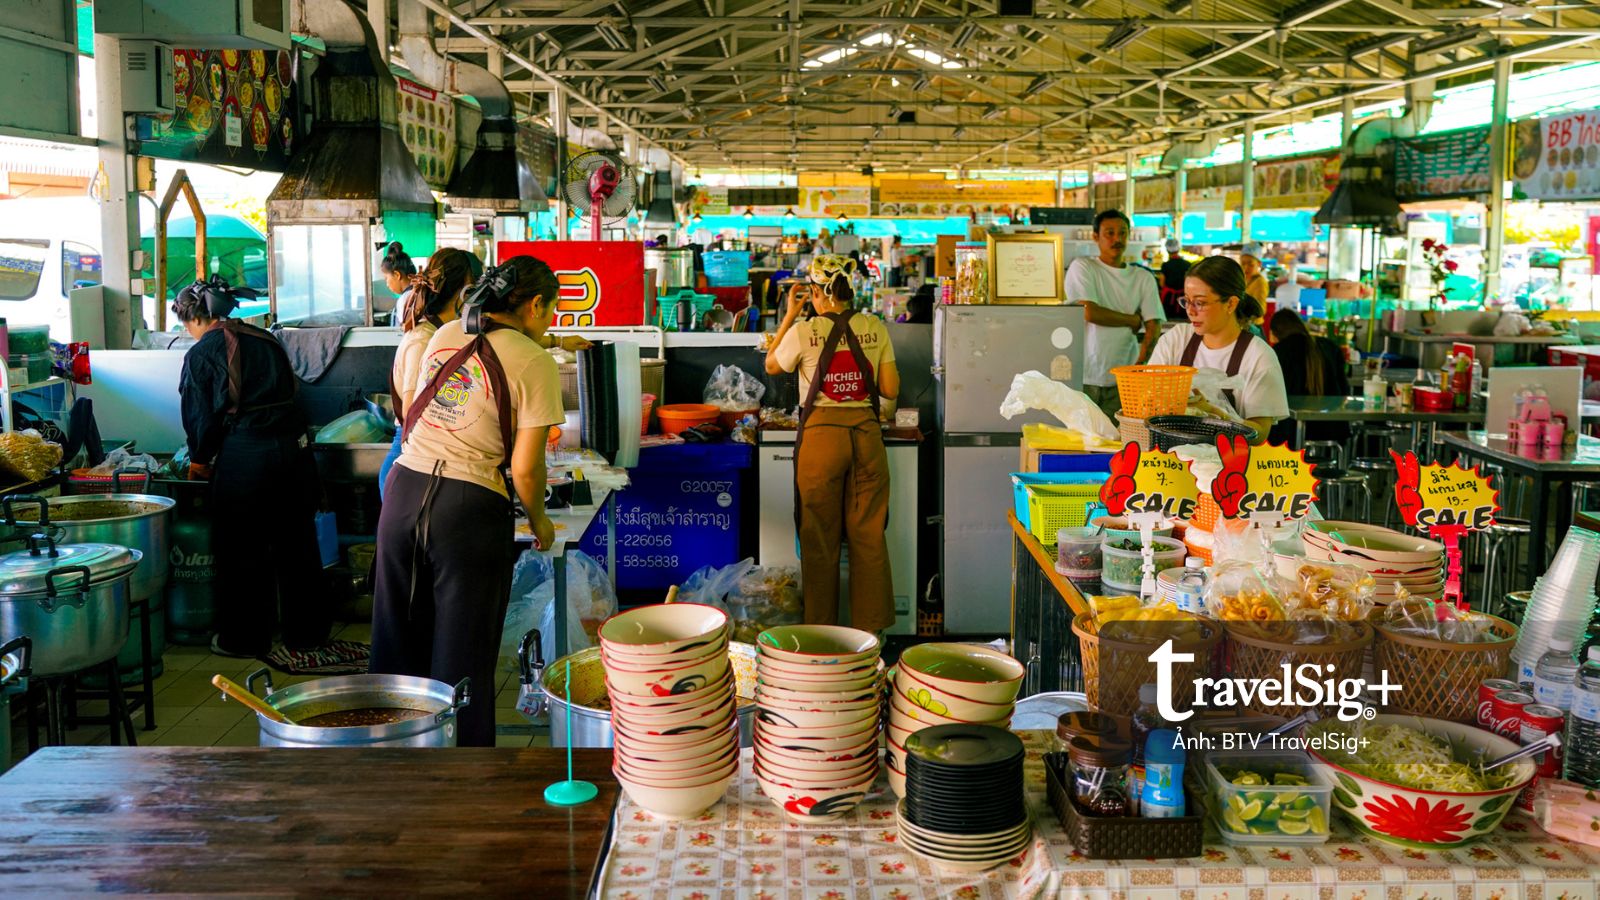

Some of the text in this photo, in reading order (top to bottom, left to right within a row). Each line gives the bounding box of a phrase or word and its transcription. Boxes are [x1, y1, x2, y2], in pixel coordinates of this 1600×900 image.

[832, 382, 858, 393] 2026
[680, 480, 733, 493] G20057
[1125, 492, 1196, 520] SALE
[1239, 492, 1312, 519] SALE
[1416, 506, 1493, 532] SALE
[593, 534, 673, 547] 05-226056
